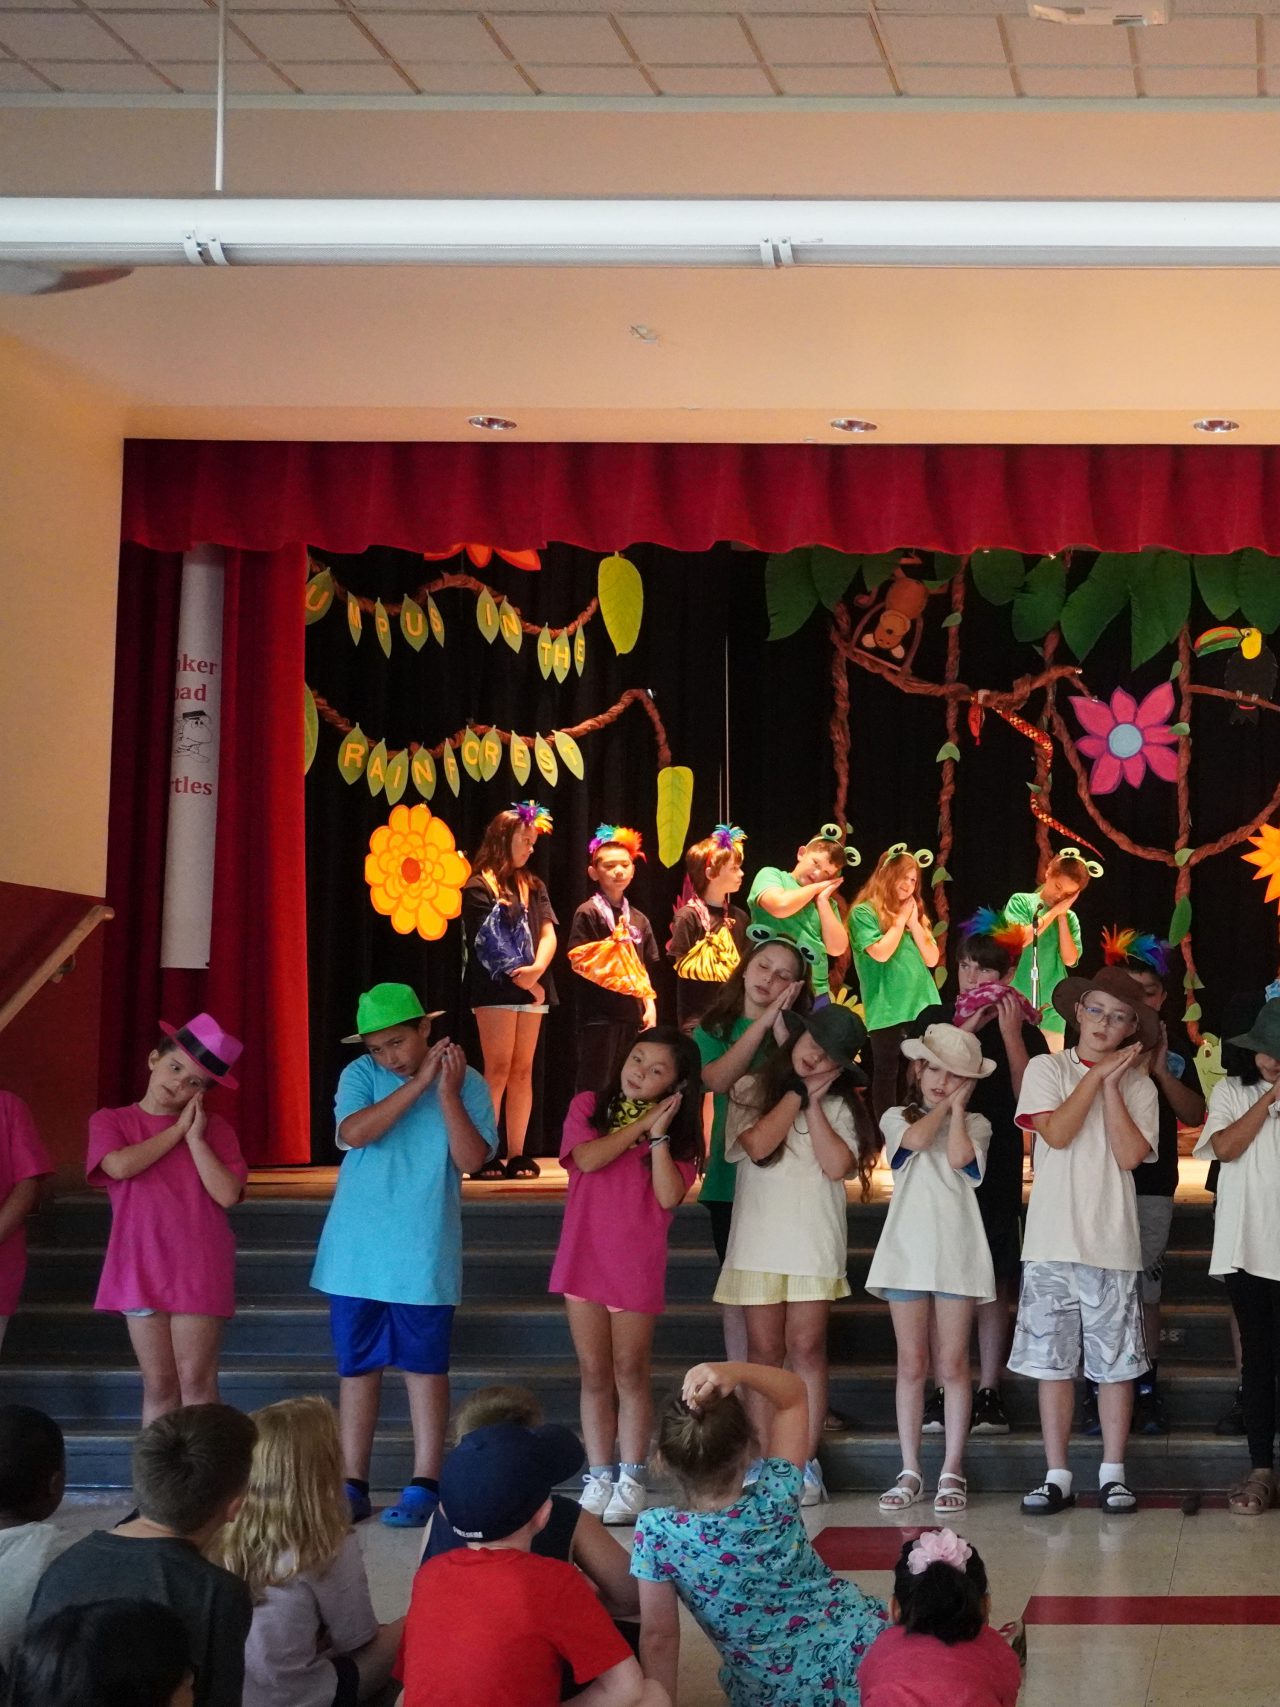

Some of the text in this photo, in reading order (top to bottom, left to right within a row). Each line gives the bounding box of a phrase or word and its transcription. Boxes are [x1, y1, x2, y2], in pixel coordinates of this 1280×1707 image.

[485, 603, 521, 637] IN
[540, 639, 586, 671] THE
[171, 776, 213, 796] tles
[342, 742, 579, 789] RAINFOREST
